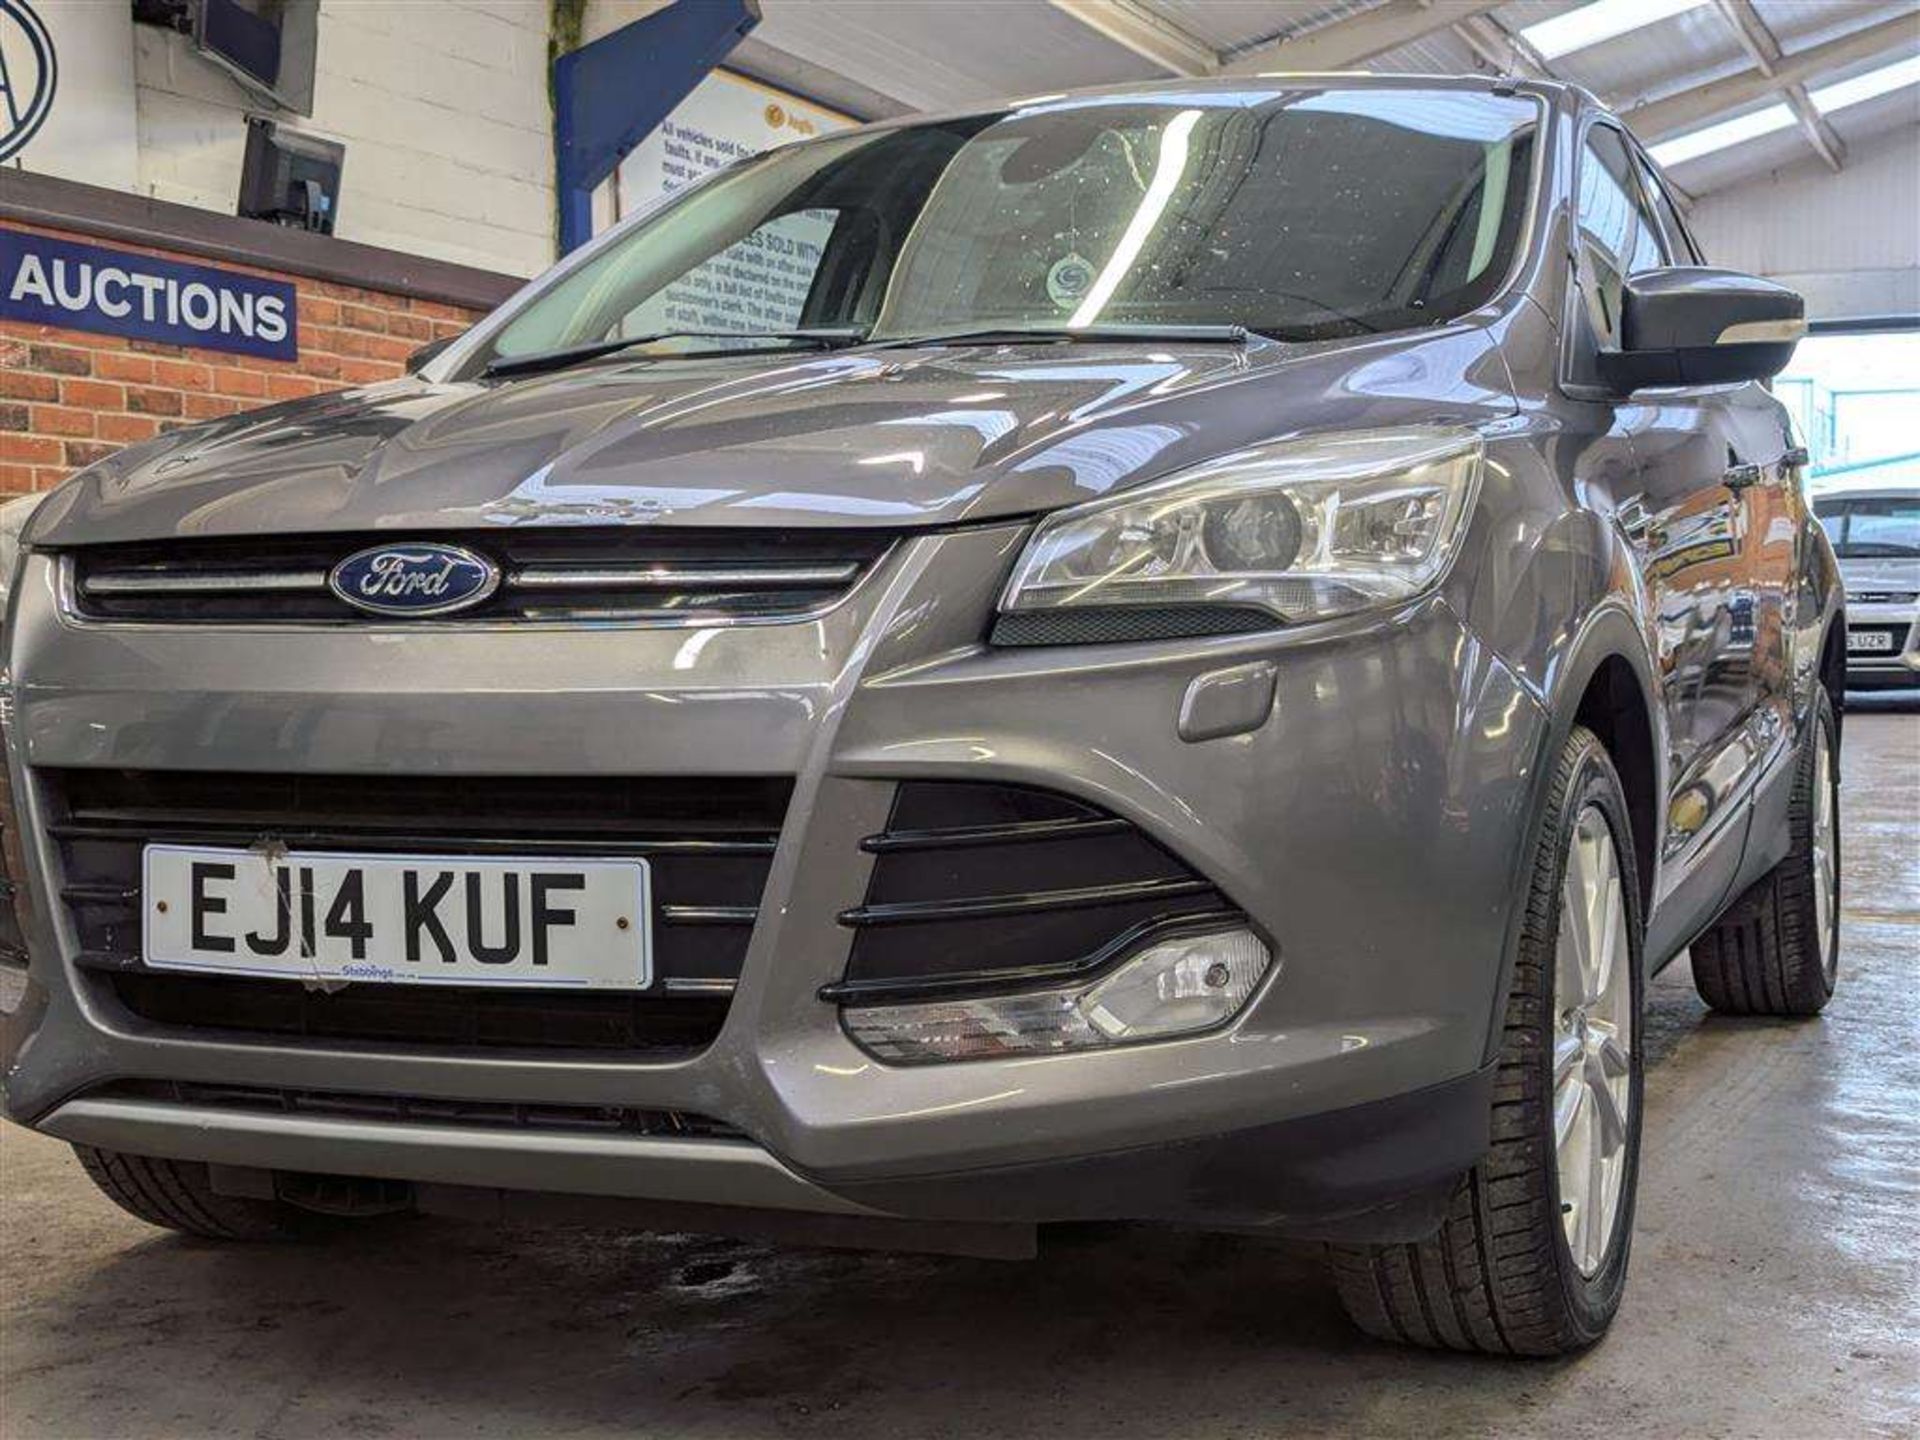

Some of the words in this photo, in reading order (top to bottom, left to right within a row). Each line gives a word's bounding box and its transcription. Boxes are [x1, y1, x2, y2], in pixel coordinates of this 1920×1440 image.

[676, 127, 714, 150] vehicles
[766, 233, 794, 255] SOLD
[10, 254, 287, 342] AUCTIONS
[360, 552, 464, 597] Ford
[1857, 634, 1887, 649] UZR
[191, 861, 374, 960] EJ14
[402, 869, 587, 966] KUF
